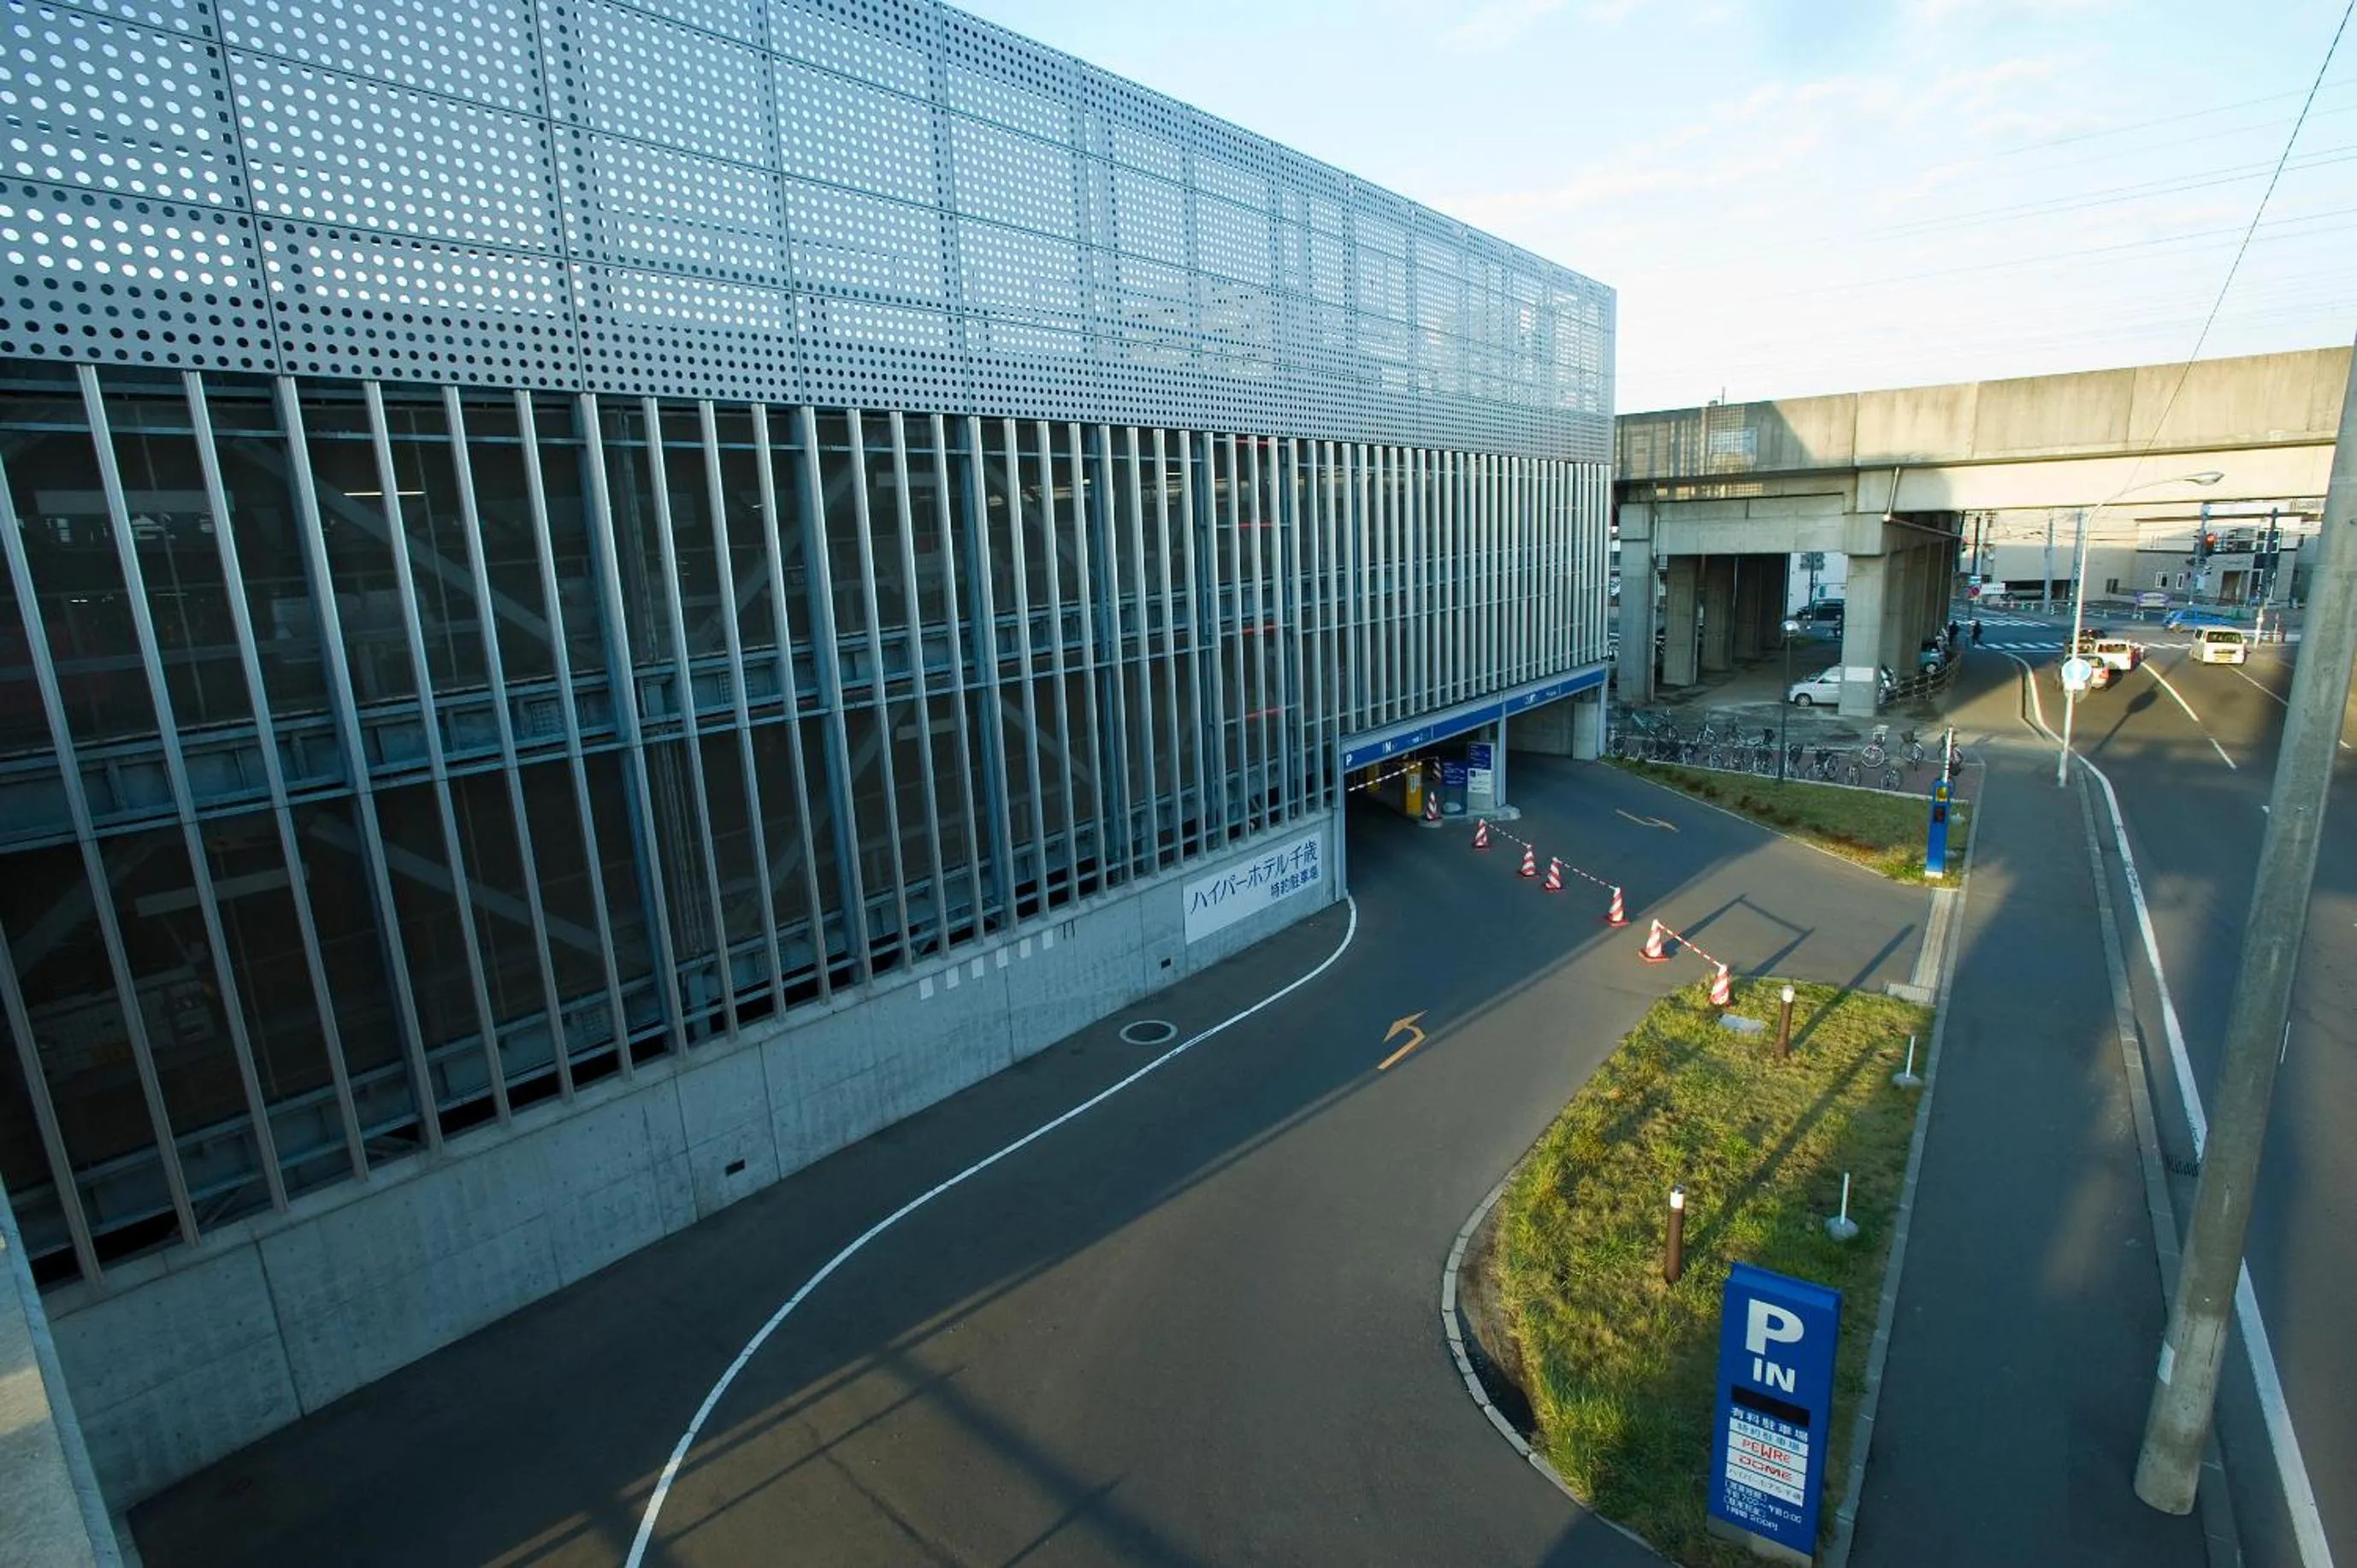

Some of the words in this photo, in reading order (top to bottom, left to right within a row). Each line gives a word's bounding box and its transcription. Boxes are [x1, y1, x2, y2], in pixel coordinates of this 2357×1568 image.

[1190, 838, 1318, 914] ハイパーホテル千歳
[1746, 1298, 1805, 1355] P
[1753, 1358, 1796, 1394] IN
